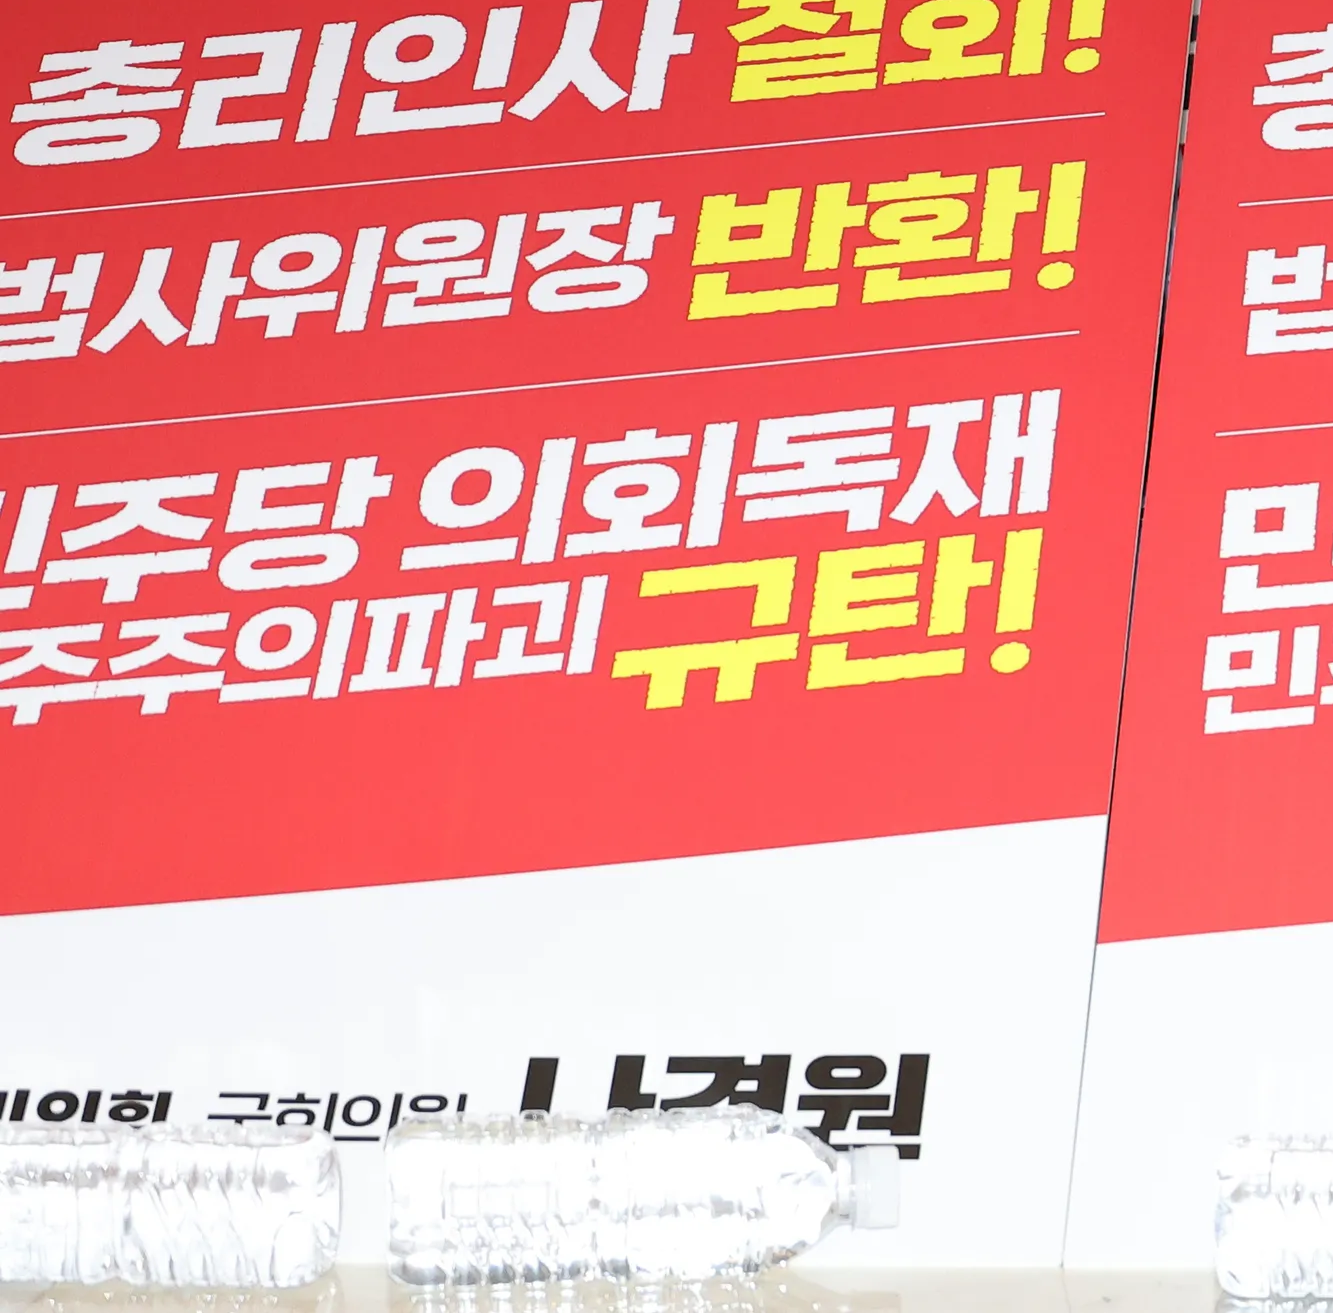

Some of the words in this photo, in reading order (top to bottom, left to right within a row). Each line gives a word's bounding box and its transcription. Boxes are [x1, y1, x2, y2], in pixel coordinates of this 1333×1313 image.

[0, 201, 674, 362] 법사위원장
[687, 161, 1087, 320] 반환!
[400, 389, 1061, 570] 의회독재
[611, 528, 1044, 711] 규탄!
